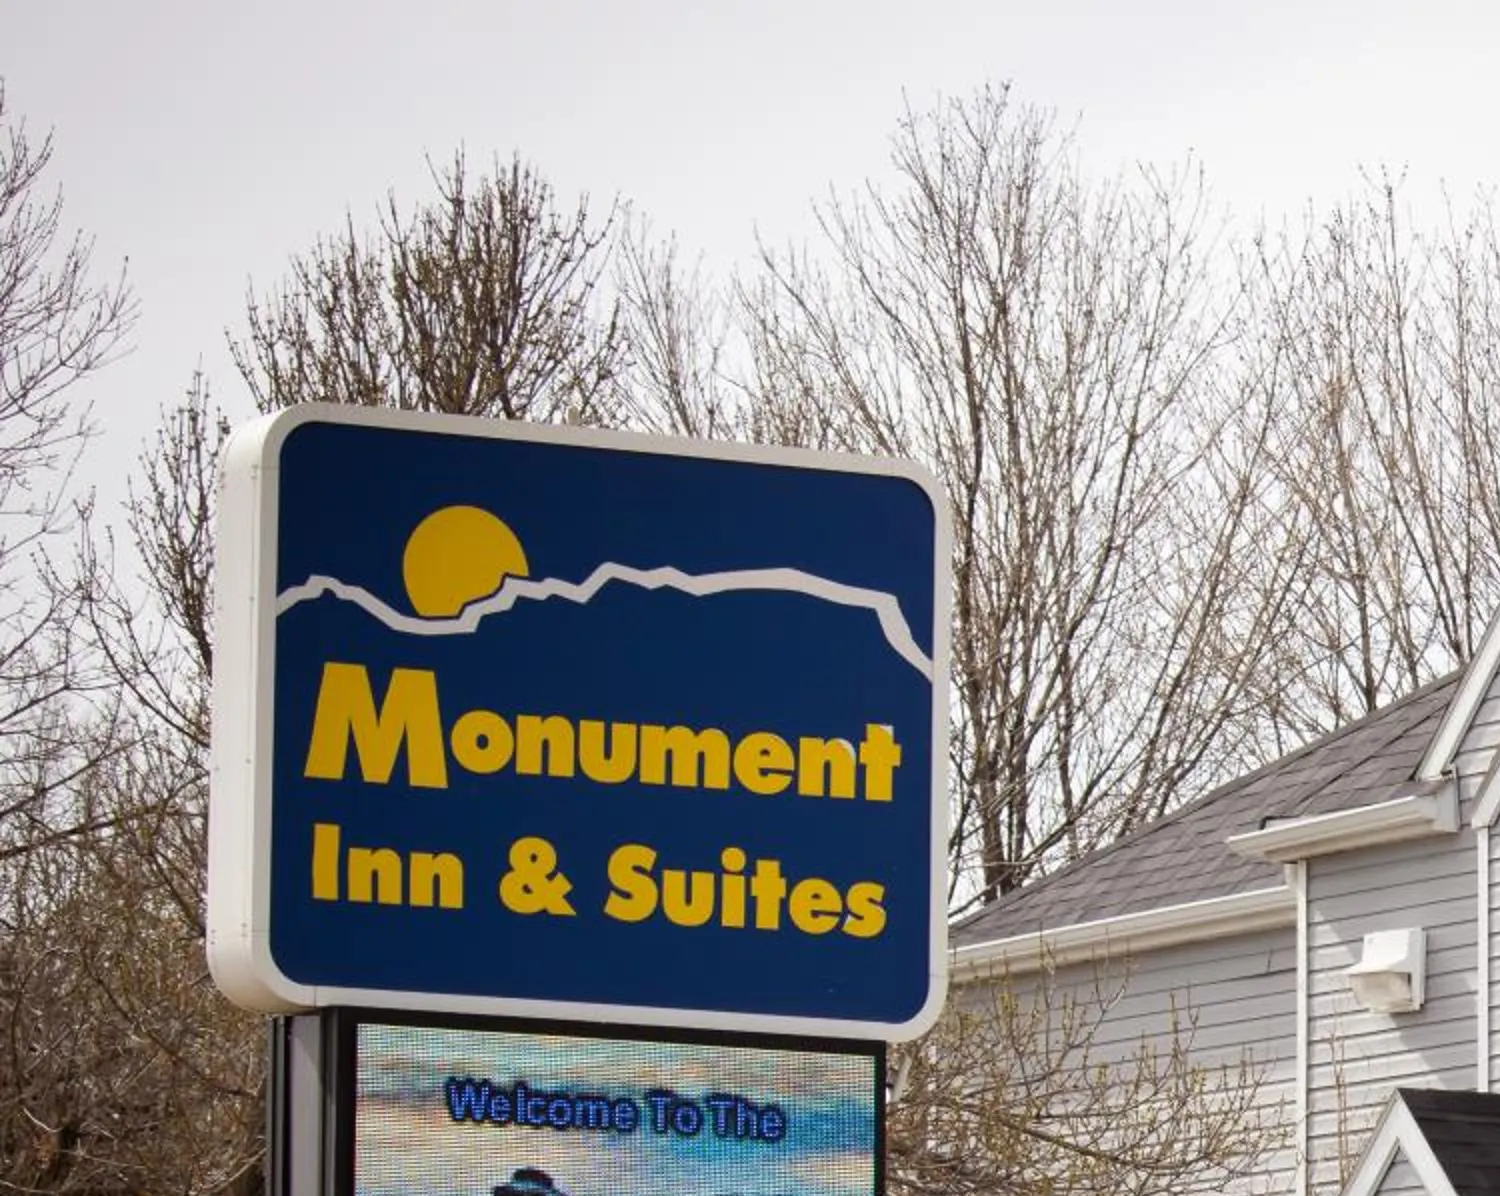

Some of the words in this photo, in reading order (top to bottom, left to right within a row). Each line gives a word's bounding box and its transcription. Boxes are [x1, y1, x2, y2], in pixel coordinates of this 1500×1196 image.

[305, 662, 901, 802] Monument
[313, 824, 463, 909] Inn
[500, 837, 576, 916] &
[604, 844, 887, 938] Suites
[448, 1079, 638, 1131] Welcome
[648, 1092, 700, 1135] To
[711, 1096, 786, 1140] The
